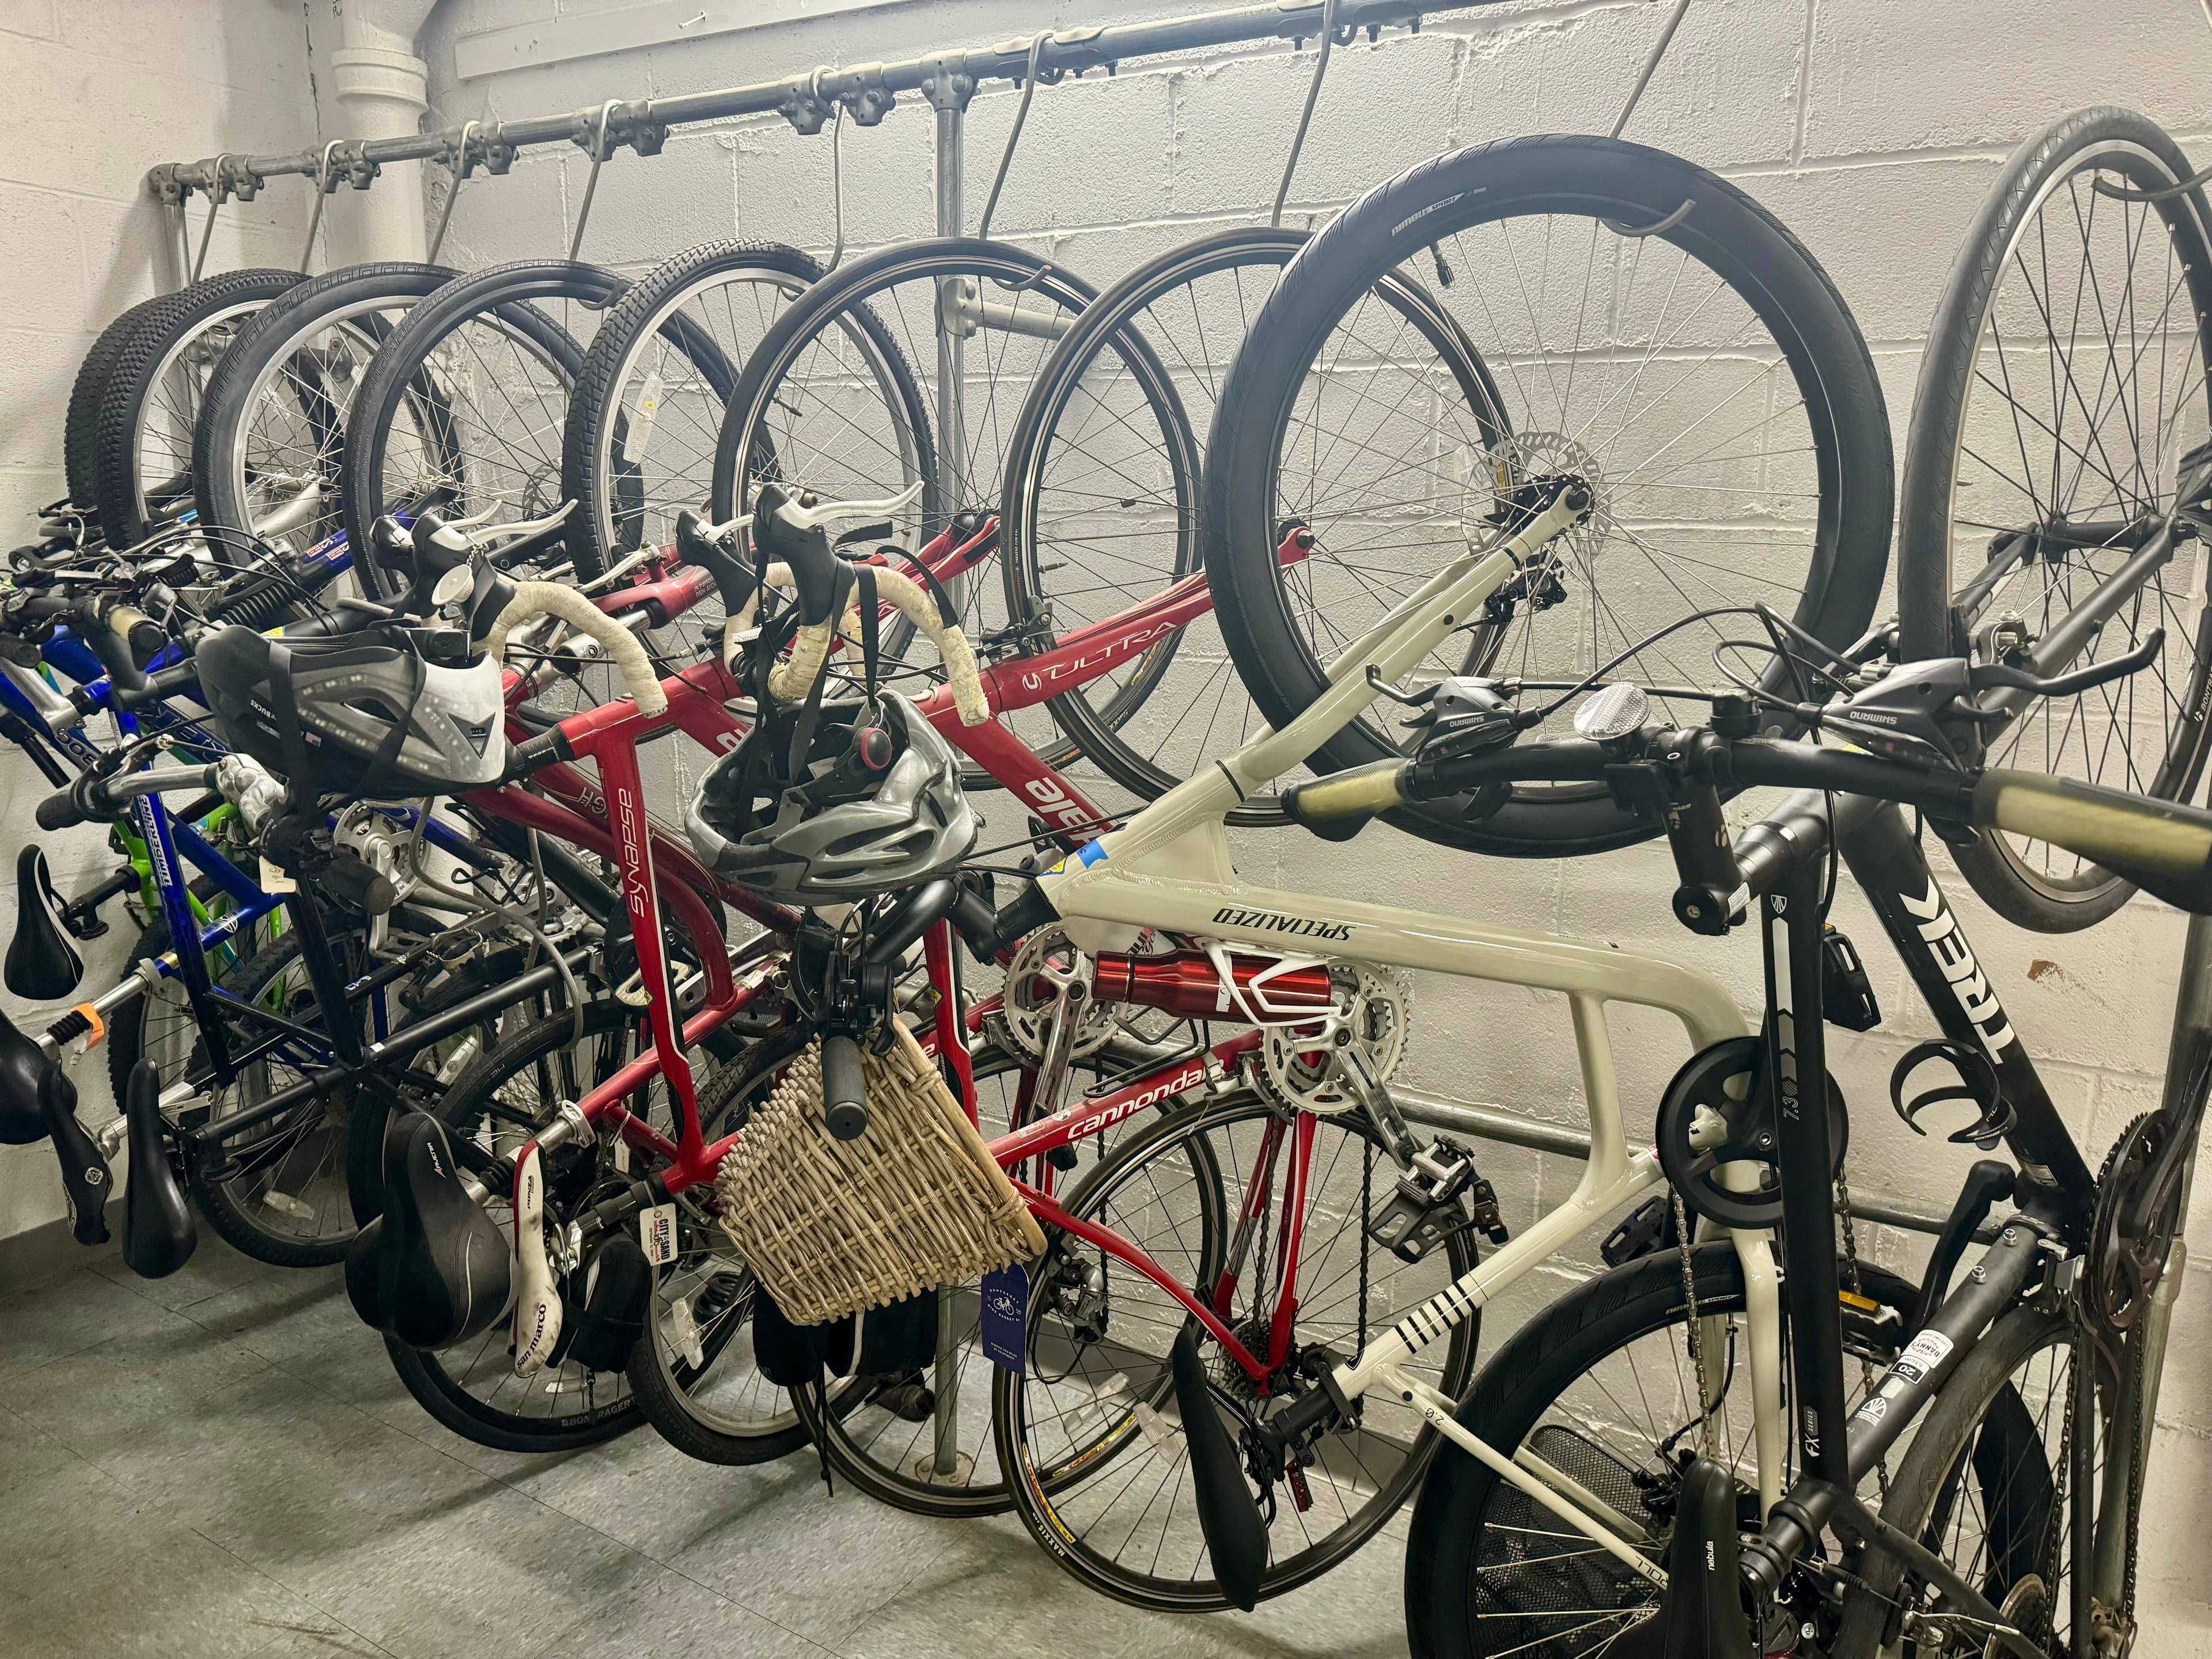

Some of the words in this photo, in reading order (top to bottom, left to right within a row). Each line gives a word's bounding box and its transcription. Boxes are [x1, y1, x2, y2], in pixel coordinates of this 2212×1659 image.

[1431, 196, 1457, 210] SPORT
[1041, 622, 1177, 680] ULTRA
[2200, 666, 2212, 711] BONTRA
[1449, 716, 1484, 727] SHIMANO
[1850, 711, 1898, 725] SHIMANO
[138, 794, 173, 887] TIMBERLINE
[1212, 908, 1358, 941] SPECIALIZED
[1898, 874, 2016, 1065] TREK
[1067, 1060, 1224, 1140] cannondal
[1782, 1096, 1799, 1120] 7.3
[659, 1218, 669, 1236] CITY
[660, 1240, 670, 1260] SAND
[517, 1350, 531, 1369] san
[530, 1304, 547, 1352] marco
[1898, 1365, 1916, 1376] 20
[568, 1399, 631, 1426] BONRAGER
[1426, 1408, 1444, 1425] 2.0
[1805, 1432, 1820, 1457] FX
[1706, 1541, 1715, 1571] nebula
